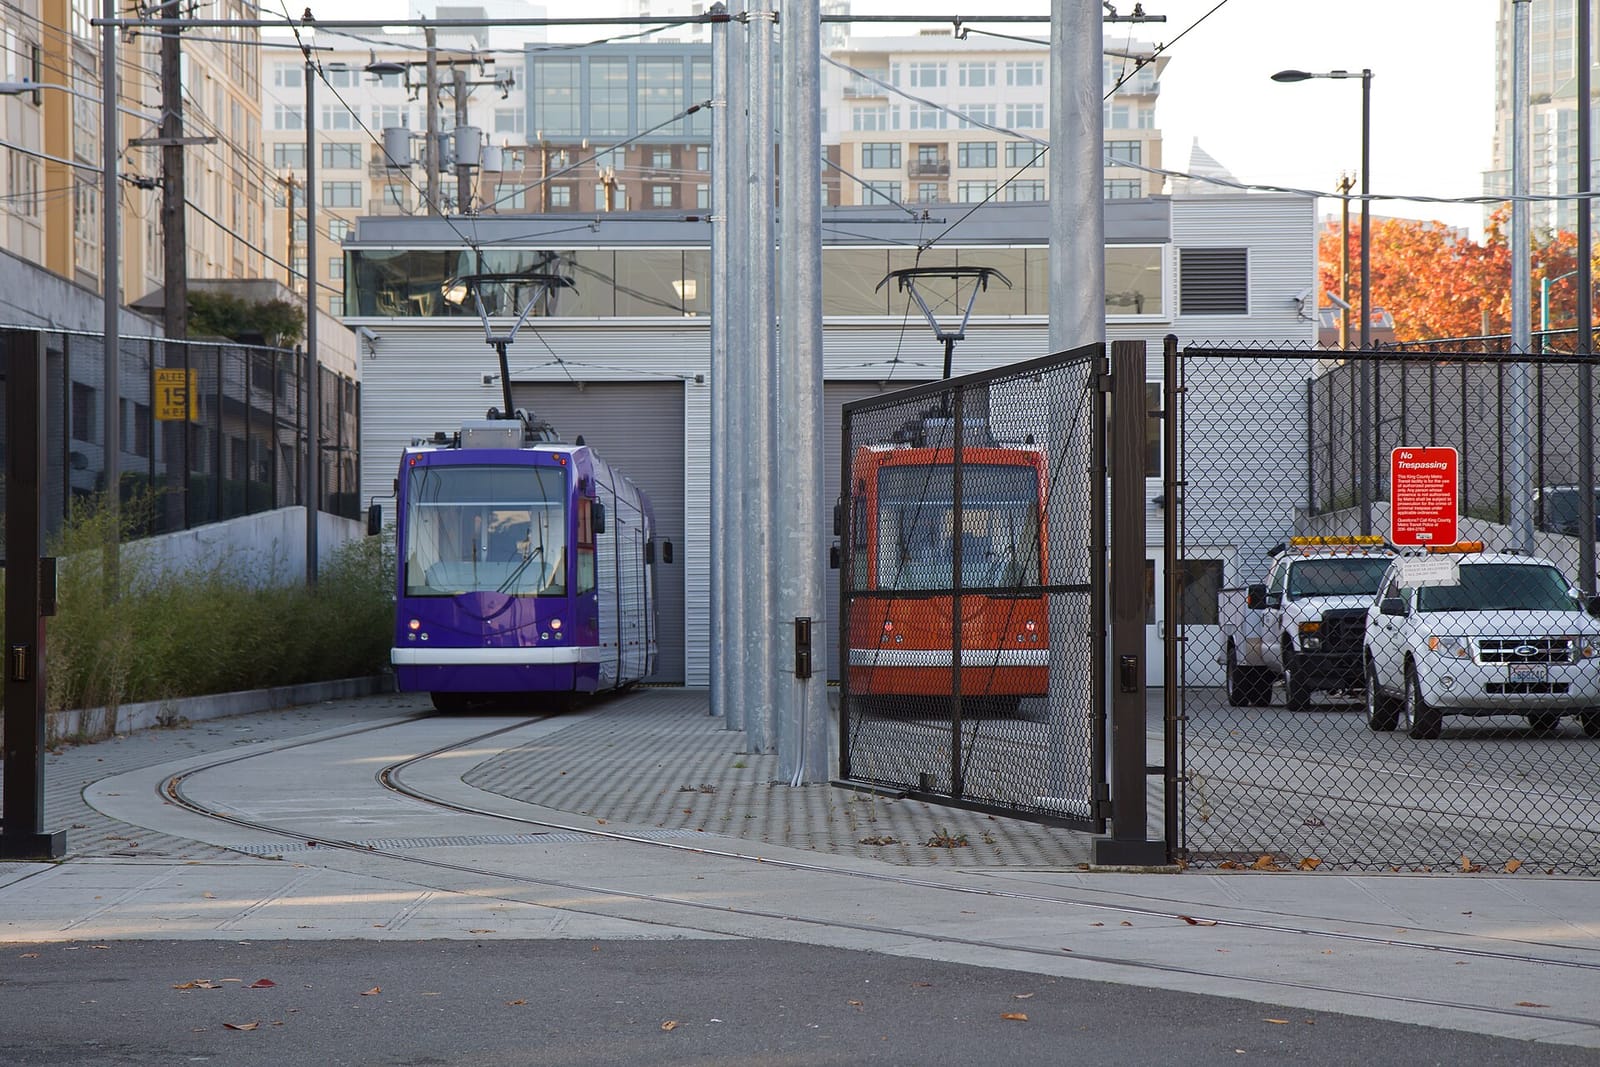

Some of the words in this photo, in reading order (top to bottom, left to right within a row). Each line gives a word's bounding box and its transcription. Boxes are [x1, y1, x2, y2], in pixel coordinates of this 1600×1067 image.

[164, 388, 186, 406] 15
[1400, 452, 1412, 460] No
[1398, 460, 1448, 470] Trespassing
